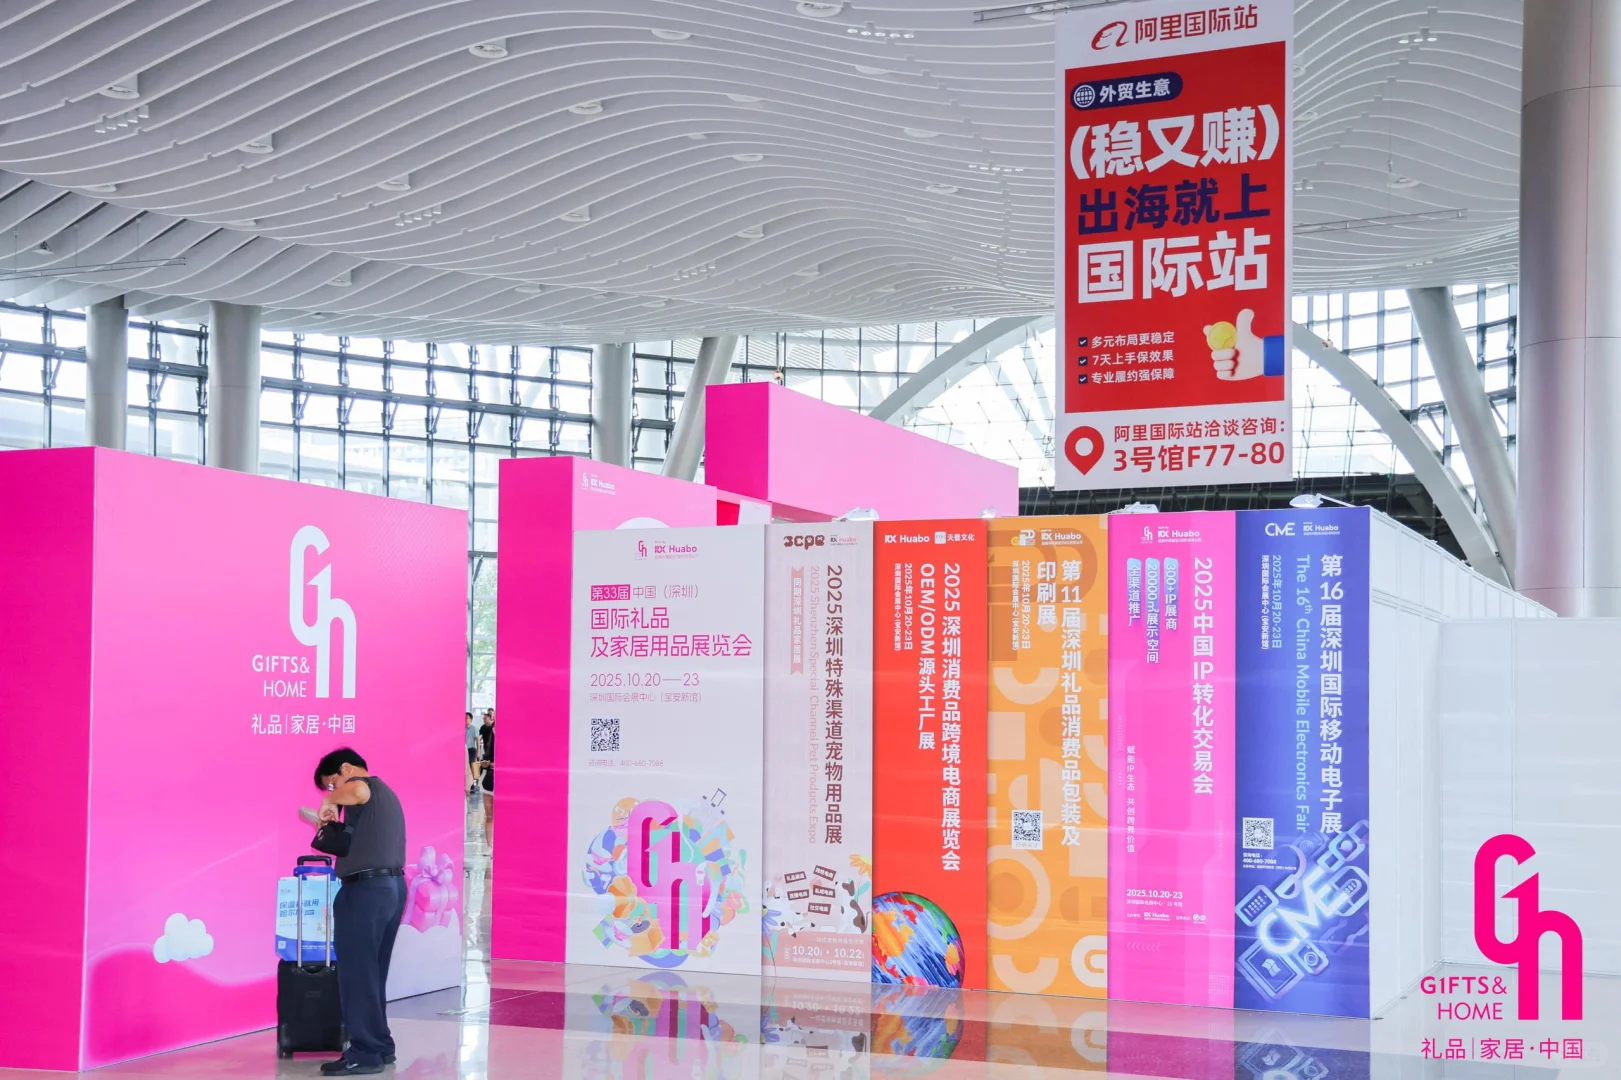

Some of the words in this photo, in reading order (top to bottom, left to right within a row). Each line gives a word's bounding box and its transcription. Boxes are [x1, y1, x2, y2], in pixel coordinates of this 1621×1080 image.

[1135, 4, 1258, 43] 阿里国际站
[1100, 78, 1171, 103] 外贸生意
[1078, 173, 1270, 235] 出海就上
[1078, 228, 1270, 304] 国际站
[1091, 331, 1174, 348] 多元布局更稳定
[1092, 350, 1174, 366] 7天上手保效果
[1091, 368, 1174, 384] 专业履约强保障
[1113, 442, 1284, 473] 3号馆F77-80
[900, 534, 930, 543] Huabo
[1054, 532, 1081, 540] Huabo
[1265, 522, 1295, 537] CME
[1315, 524, 1339, 532] Huabo
[669, 545, 698, 553] Huabo
[810, 565, 820, 594] 2025
[1296, 554, 1310, 583] The
[591, 586, 629, 600] 第33届
[1036, 561, 1057, 625] 印刷展
[1128, 564, 1141, 627] 全渠道推广
[1165, 564, 1177, 630] 300+IP展商
[591, 607, 670, 630] 国际礼品
[808, 596, 820, 650] Shenzhen
[590, 633, 753, 658] 及家居用品展览会
[1296, 618, 1310, 660] China
[808, 652, 820, 691] Special
[1192, 557, 1214, 794] 2025中国IP转化交易会
[263, 680, 307, 698] HOME
[1061, 560, 1082, 846] 第11届深圳礼品消费品包装及
[1296, 665, 1310, 715] Mobile
[1319, 554, 1344, 834] 第16届深圳国际移动电子展
[809, 695, 820, 742] Channel
[825, 565, 844, 844] 2025深圳特殊渠道宠物用品展
[809, 743, 819, 761] Pet
[1296, 720, 1310, 800] Electronics
[809, 764, 819, 814] Products
[808, 816, 819, 844] Expo
[1296, 805, 1310, 832] Fair
[1126, 889, 1183, 899] 2025.10.20-23
